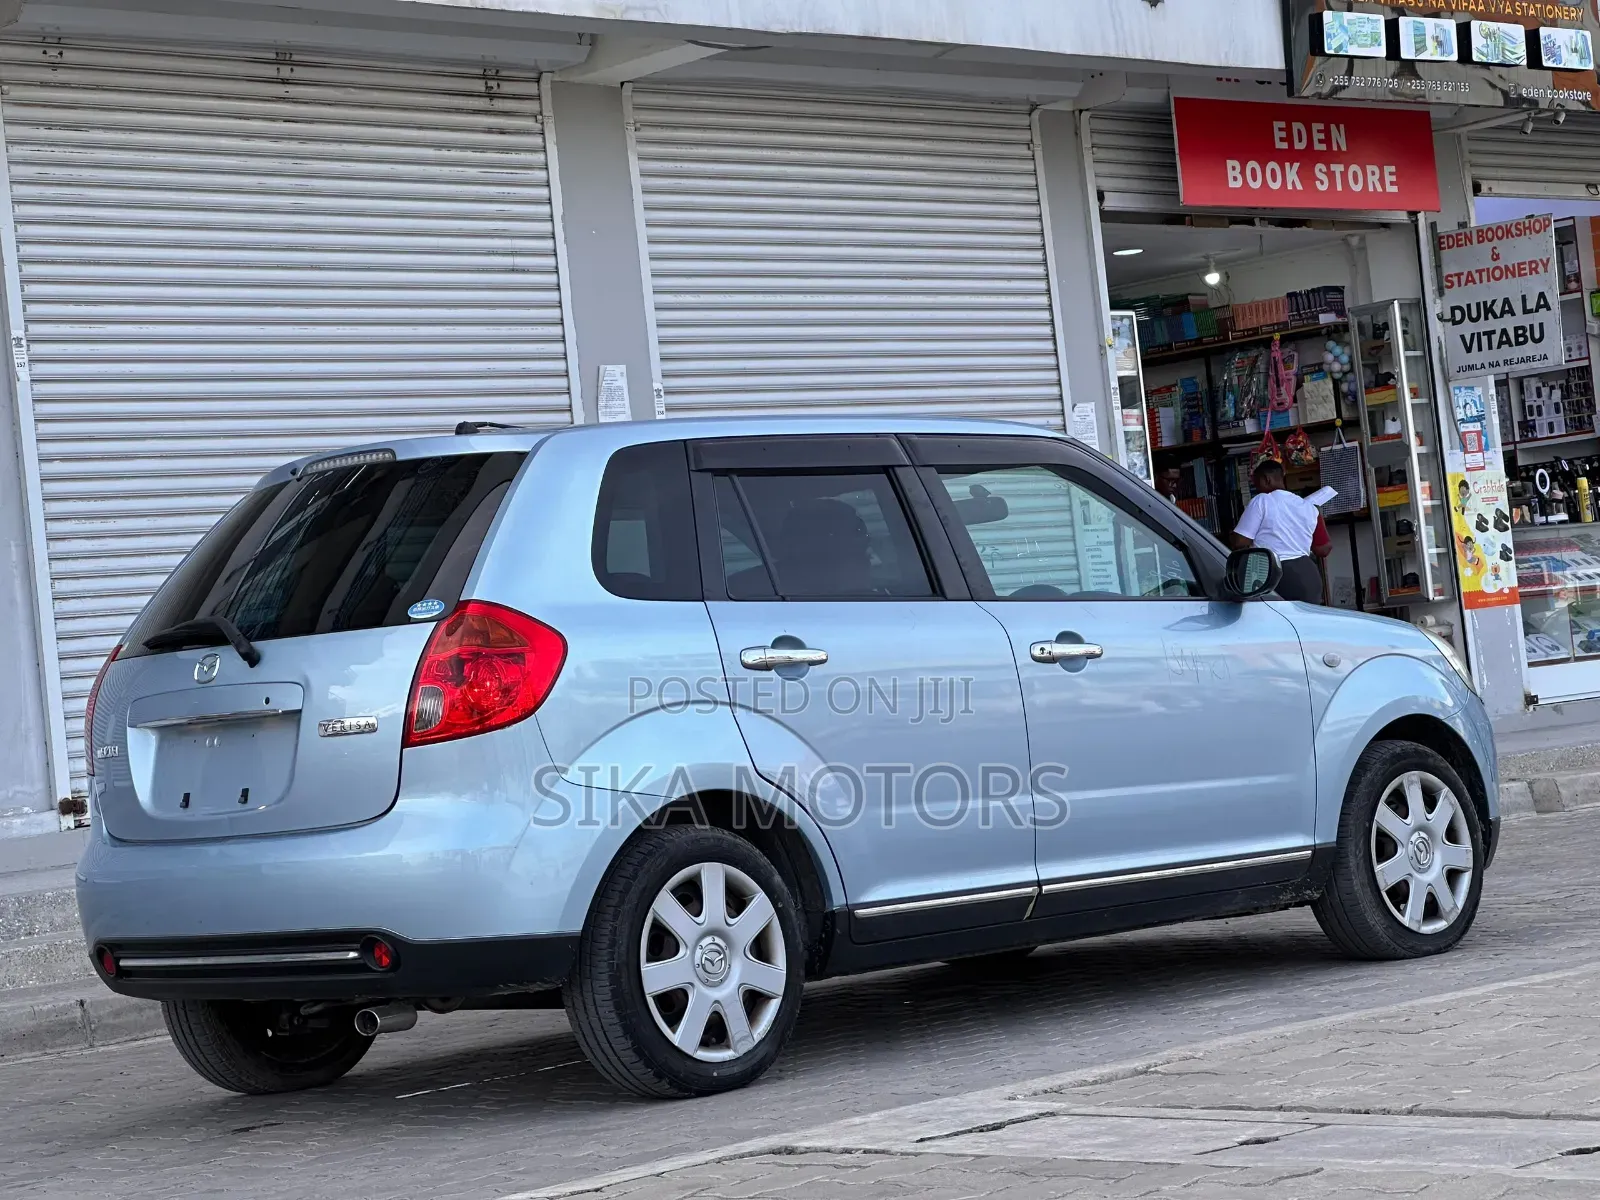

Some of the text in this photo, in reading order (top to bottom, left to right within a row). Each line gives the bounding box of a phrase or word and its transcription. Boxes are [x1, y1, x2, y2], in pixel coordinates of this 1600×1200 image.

[1428, 0, 1447, 9] NA
[1451, 0, 1486, 12] VIFAA
[1490, 1, 1513, 15] VYA
[1515, 4, 1585, 21] STATIONERY
[1329, 75, 1349, 86] +255
[1350, 76, 1365, 87] 752
[1367, 77, 1381, 88] 776
[1383, 78, 1399, 88] 706
[1406, 79, 1426, 90] +255
[1427, 80, 1441, 91] 785
[1522, 85, 1592, 100] eden.bookstore
[1272, 120, 1347, 151] EDEN
[1226, 159, 1399, 192] BOOK STORE
[1438, 217, 1552, 251] EDEN BOOKSHOP
[1490, 246, 1500, 262] &
[1444, 257, 1551, 290] STATIONERY
[1450, 291, 1552, 326] DUKA LA
[1460, 322, 1545, 354] VITABU
[1456, 353, 1549, 374] JUMLA NA REJAREJA
[321, 720, 372, 733] VERISA
